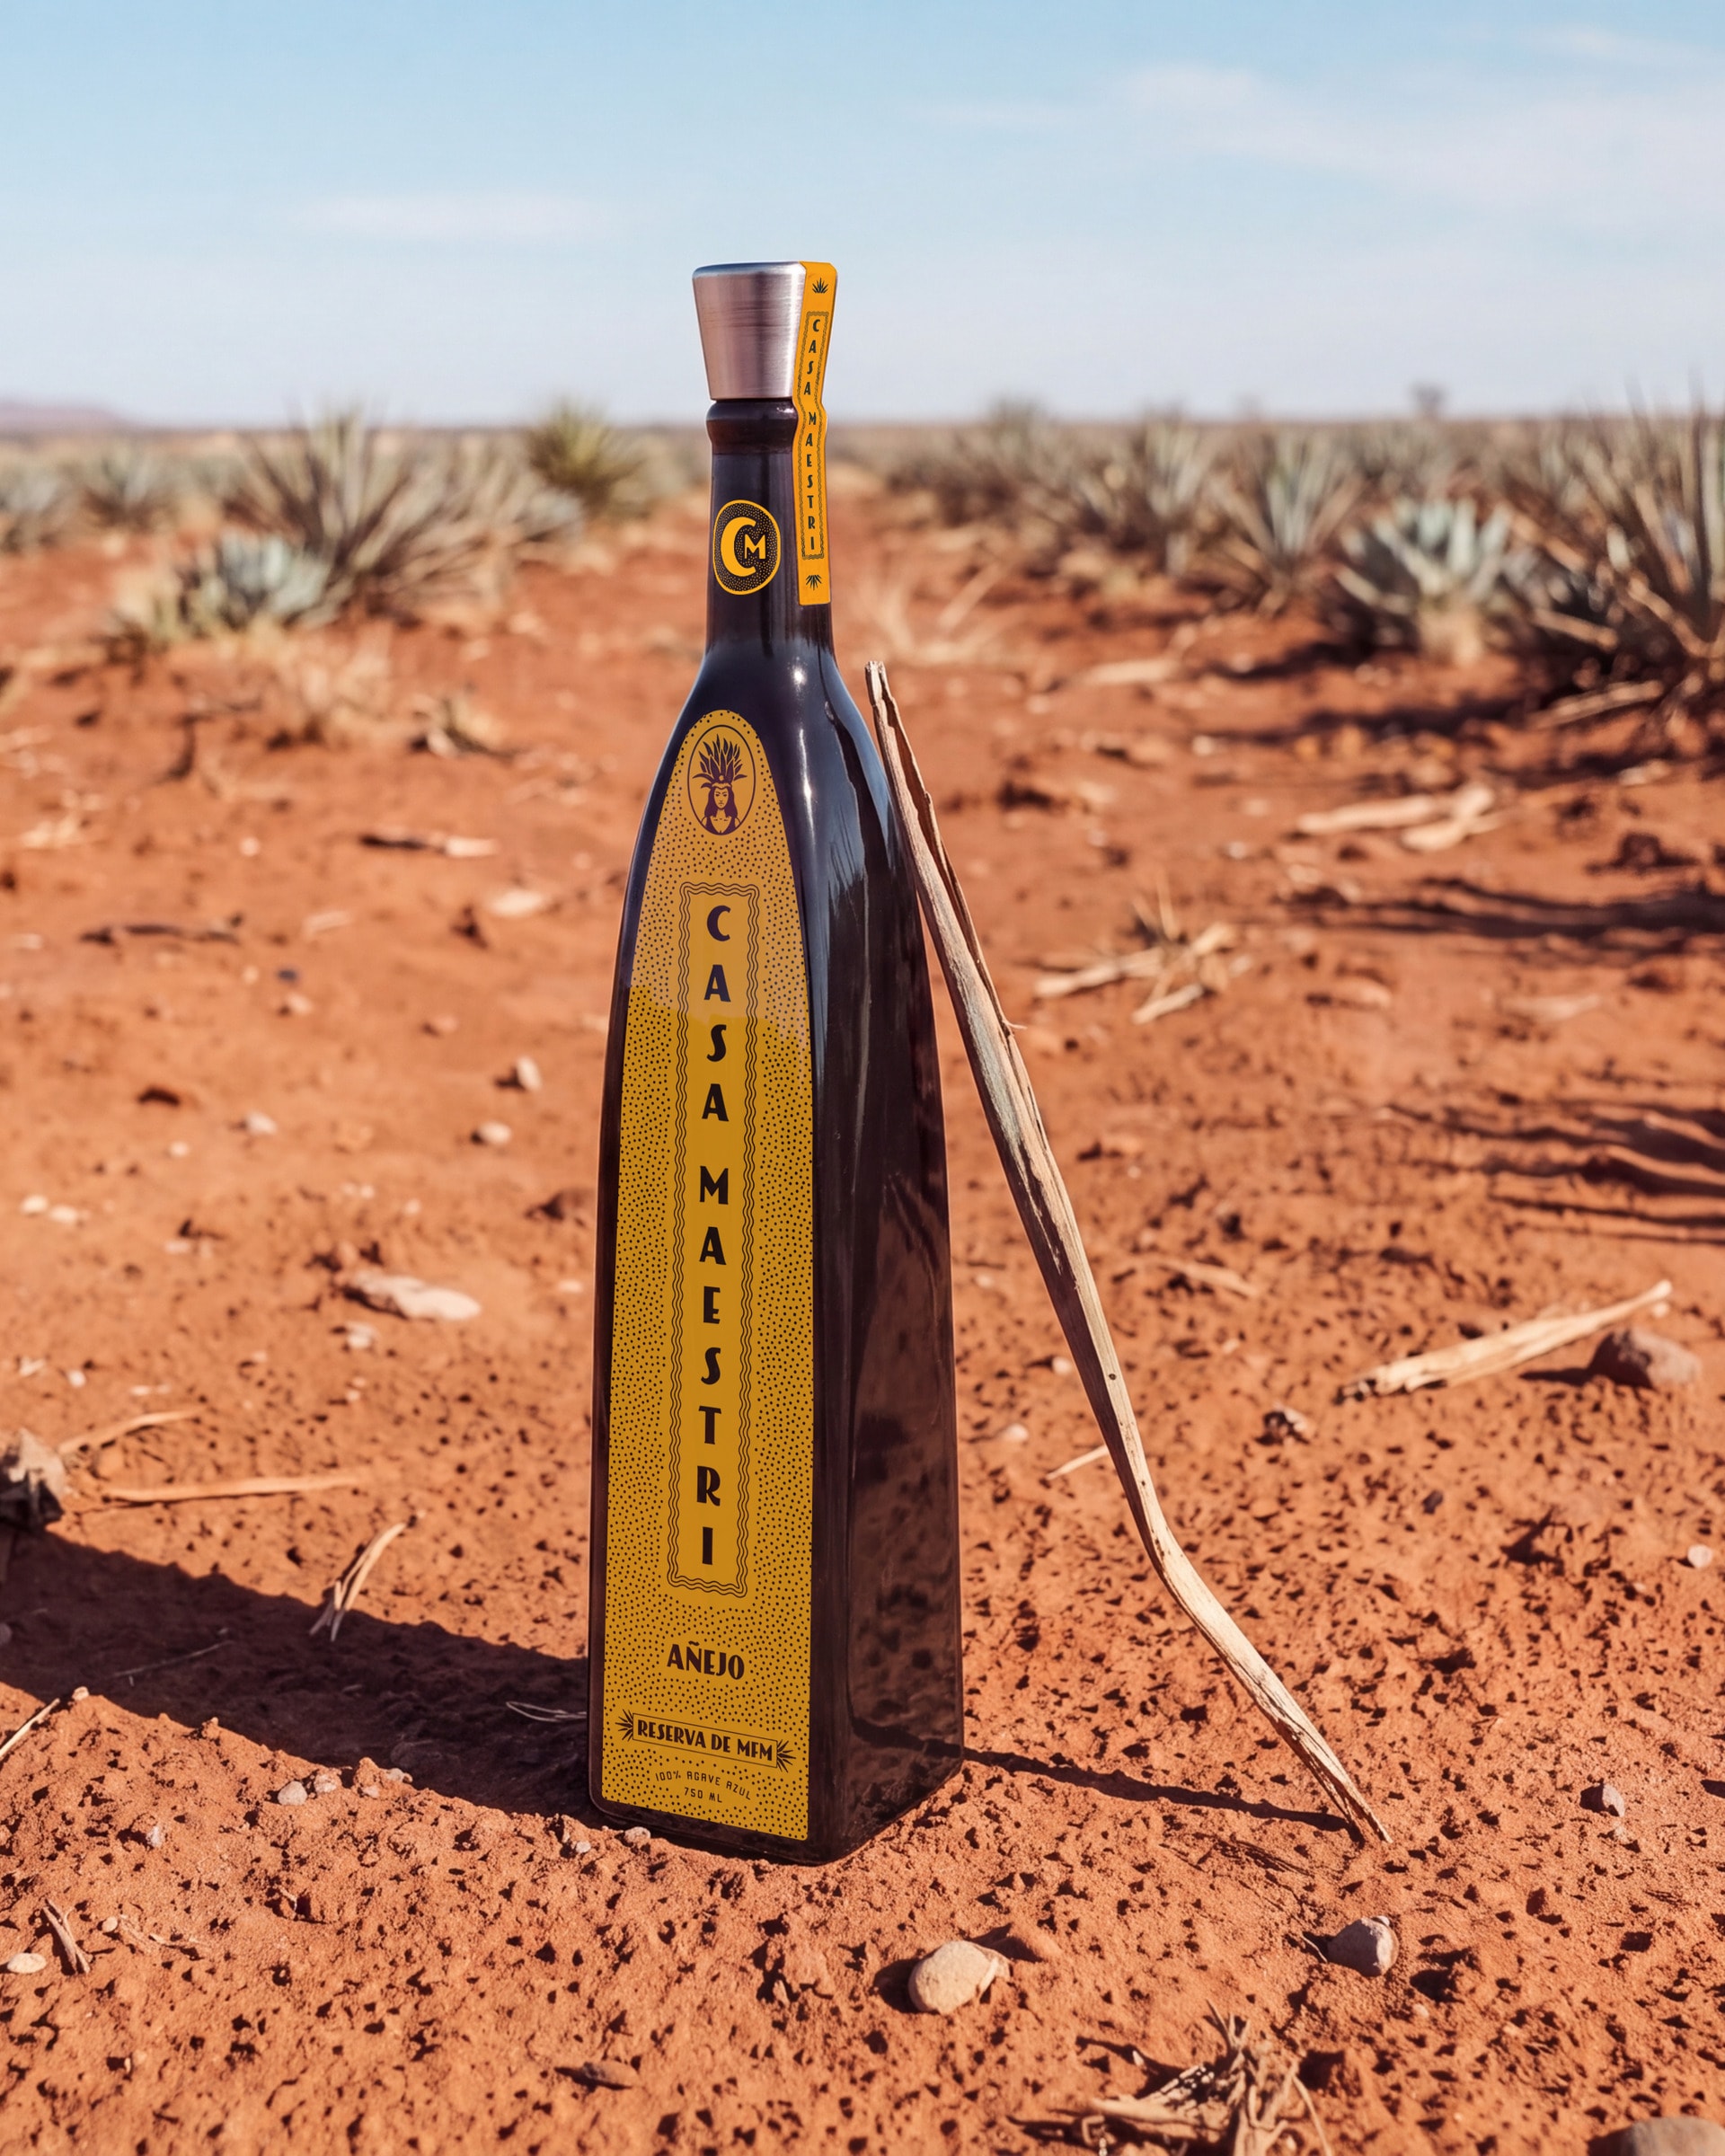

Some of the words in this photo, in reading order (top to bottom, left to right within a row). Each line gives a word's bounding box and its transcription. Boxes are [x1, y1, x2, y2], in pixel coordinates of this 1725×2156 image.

[803, 319, 821, 395] CASA
[805, 411, 817, 550] MAESTRI
[702, 905, 731, 1122] CASA
[696, 1166, 730, 1566] MAESTRI
[667, 1640, 745, 1680] AÑEJO
[637, 1719, 706, 1748] RESERVA
[711, 1734, 731, 1753] DE
[737, 1738, 773, 1761] MFM
[655, 1770, 681, 1782] 100%
[686, 1771, 721, 1786] AGAVE
[726, 1780, 751, 1800] AZUL
[684, 1787, 703, 1799] 750
[708, 1792, 722, 1803] ML
